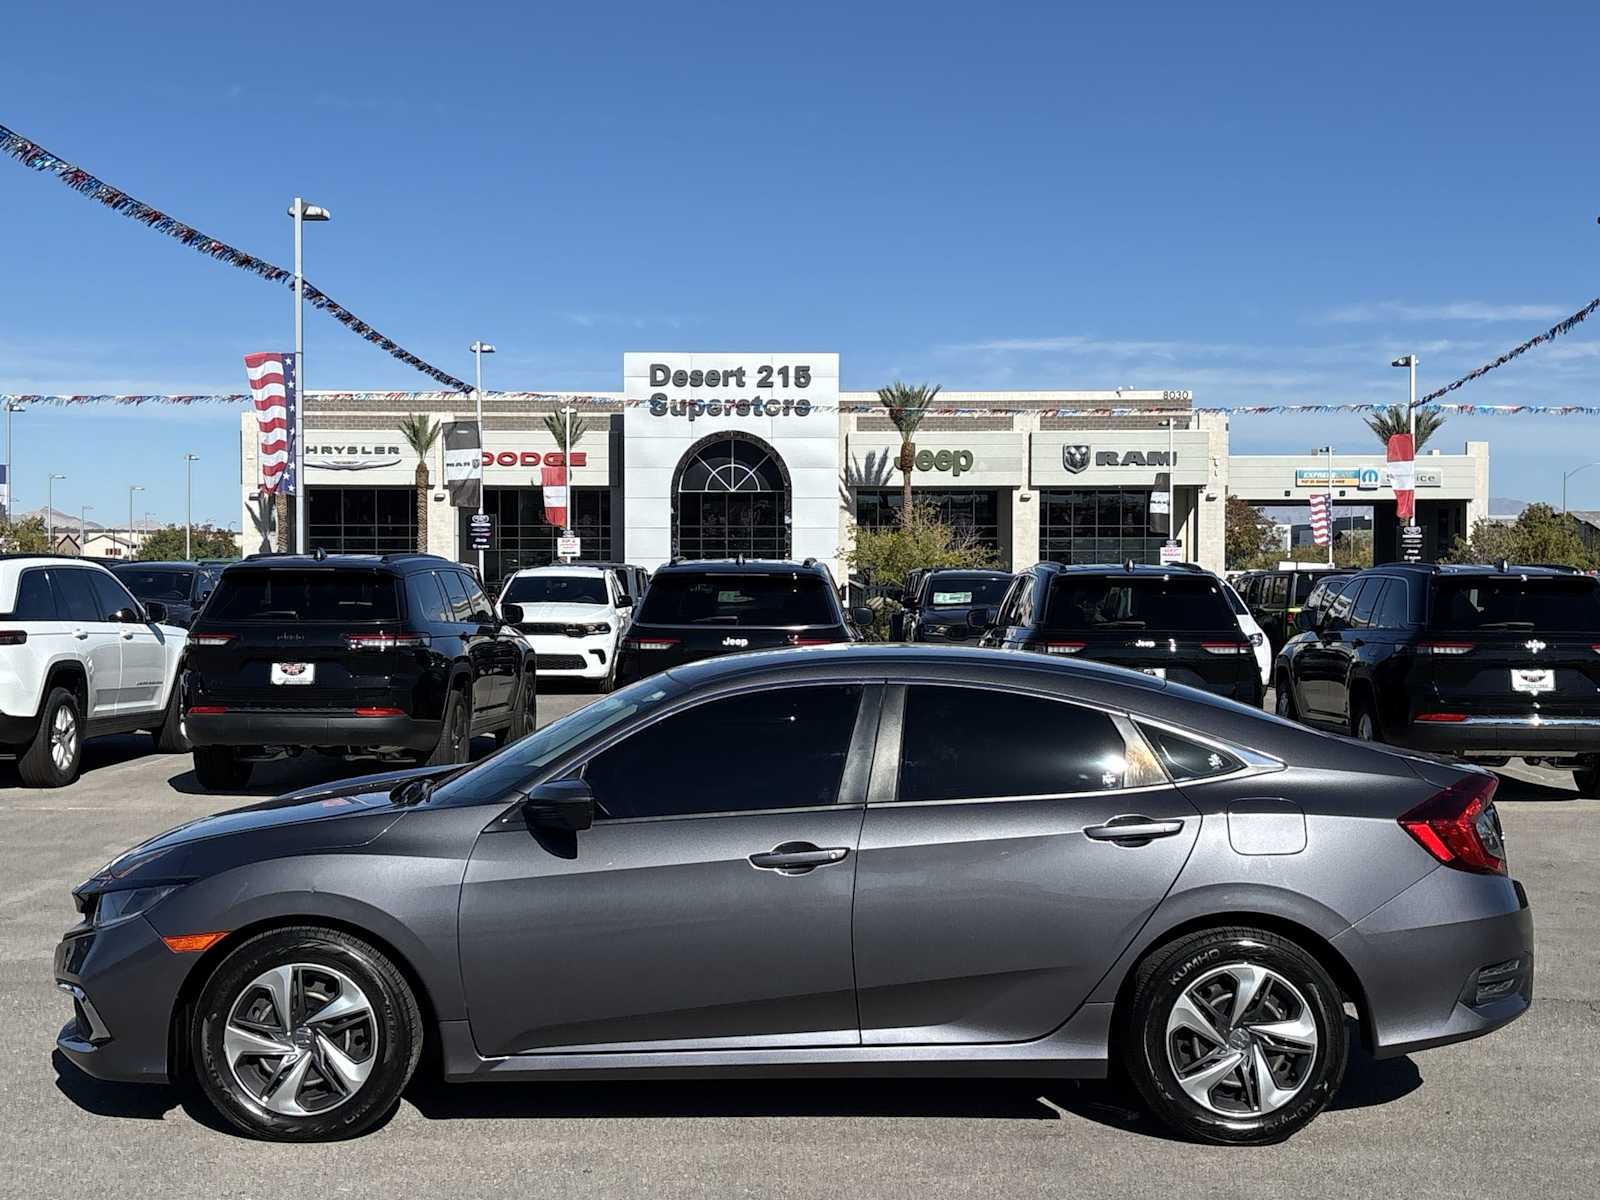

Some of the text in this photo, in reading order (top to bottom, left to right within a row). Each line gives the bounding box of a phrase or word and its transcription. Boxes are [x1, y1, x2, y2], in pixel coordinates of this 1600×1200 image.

[649, 363, 812, 388] Desert 215
[1163, 391, 1189, 400] 8030
[649, 392, 812, 421] Superstore
[305, 446, 400, 454] HRYSLER
[482, 452, 587, 466] DODGE
[1096, 451, 1178, 466] RAM
[1386, 474, 1436, 482] Sice
[722, 636, 749, 648] Jeep
[1135, 639, 1156, 648] Jeep
[1168, 948, 1221, 986] KUMHO
